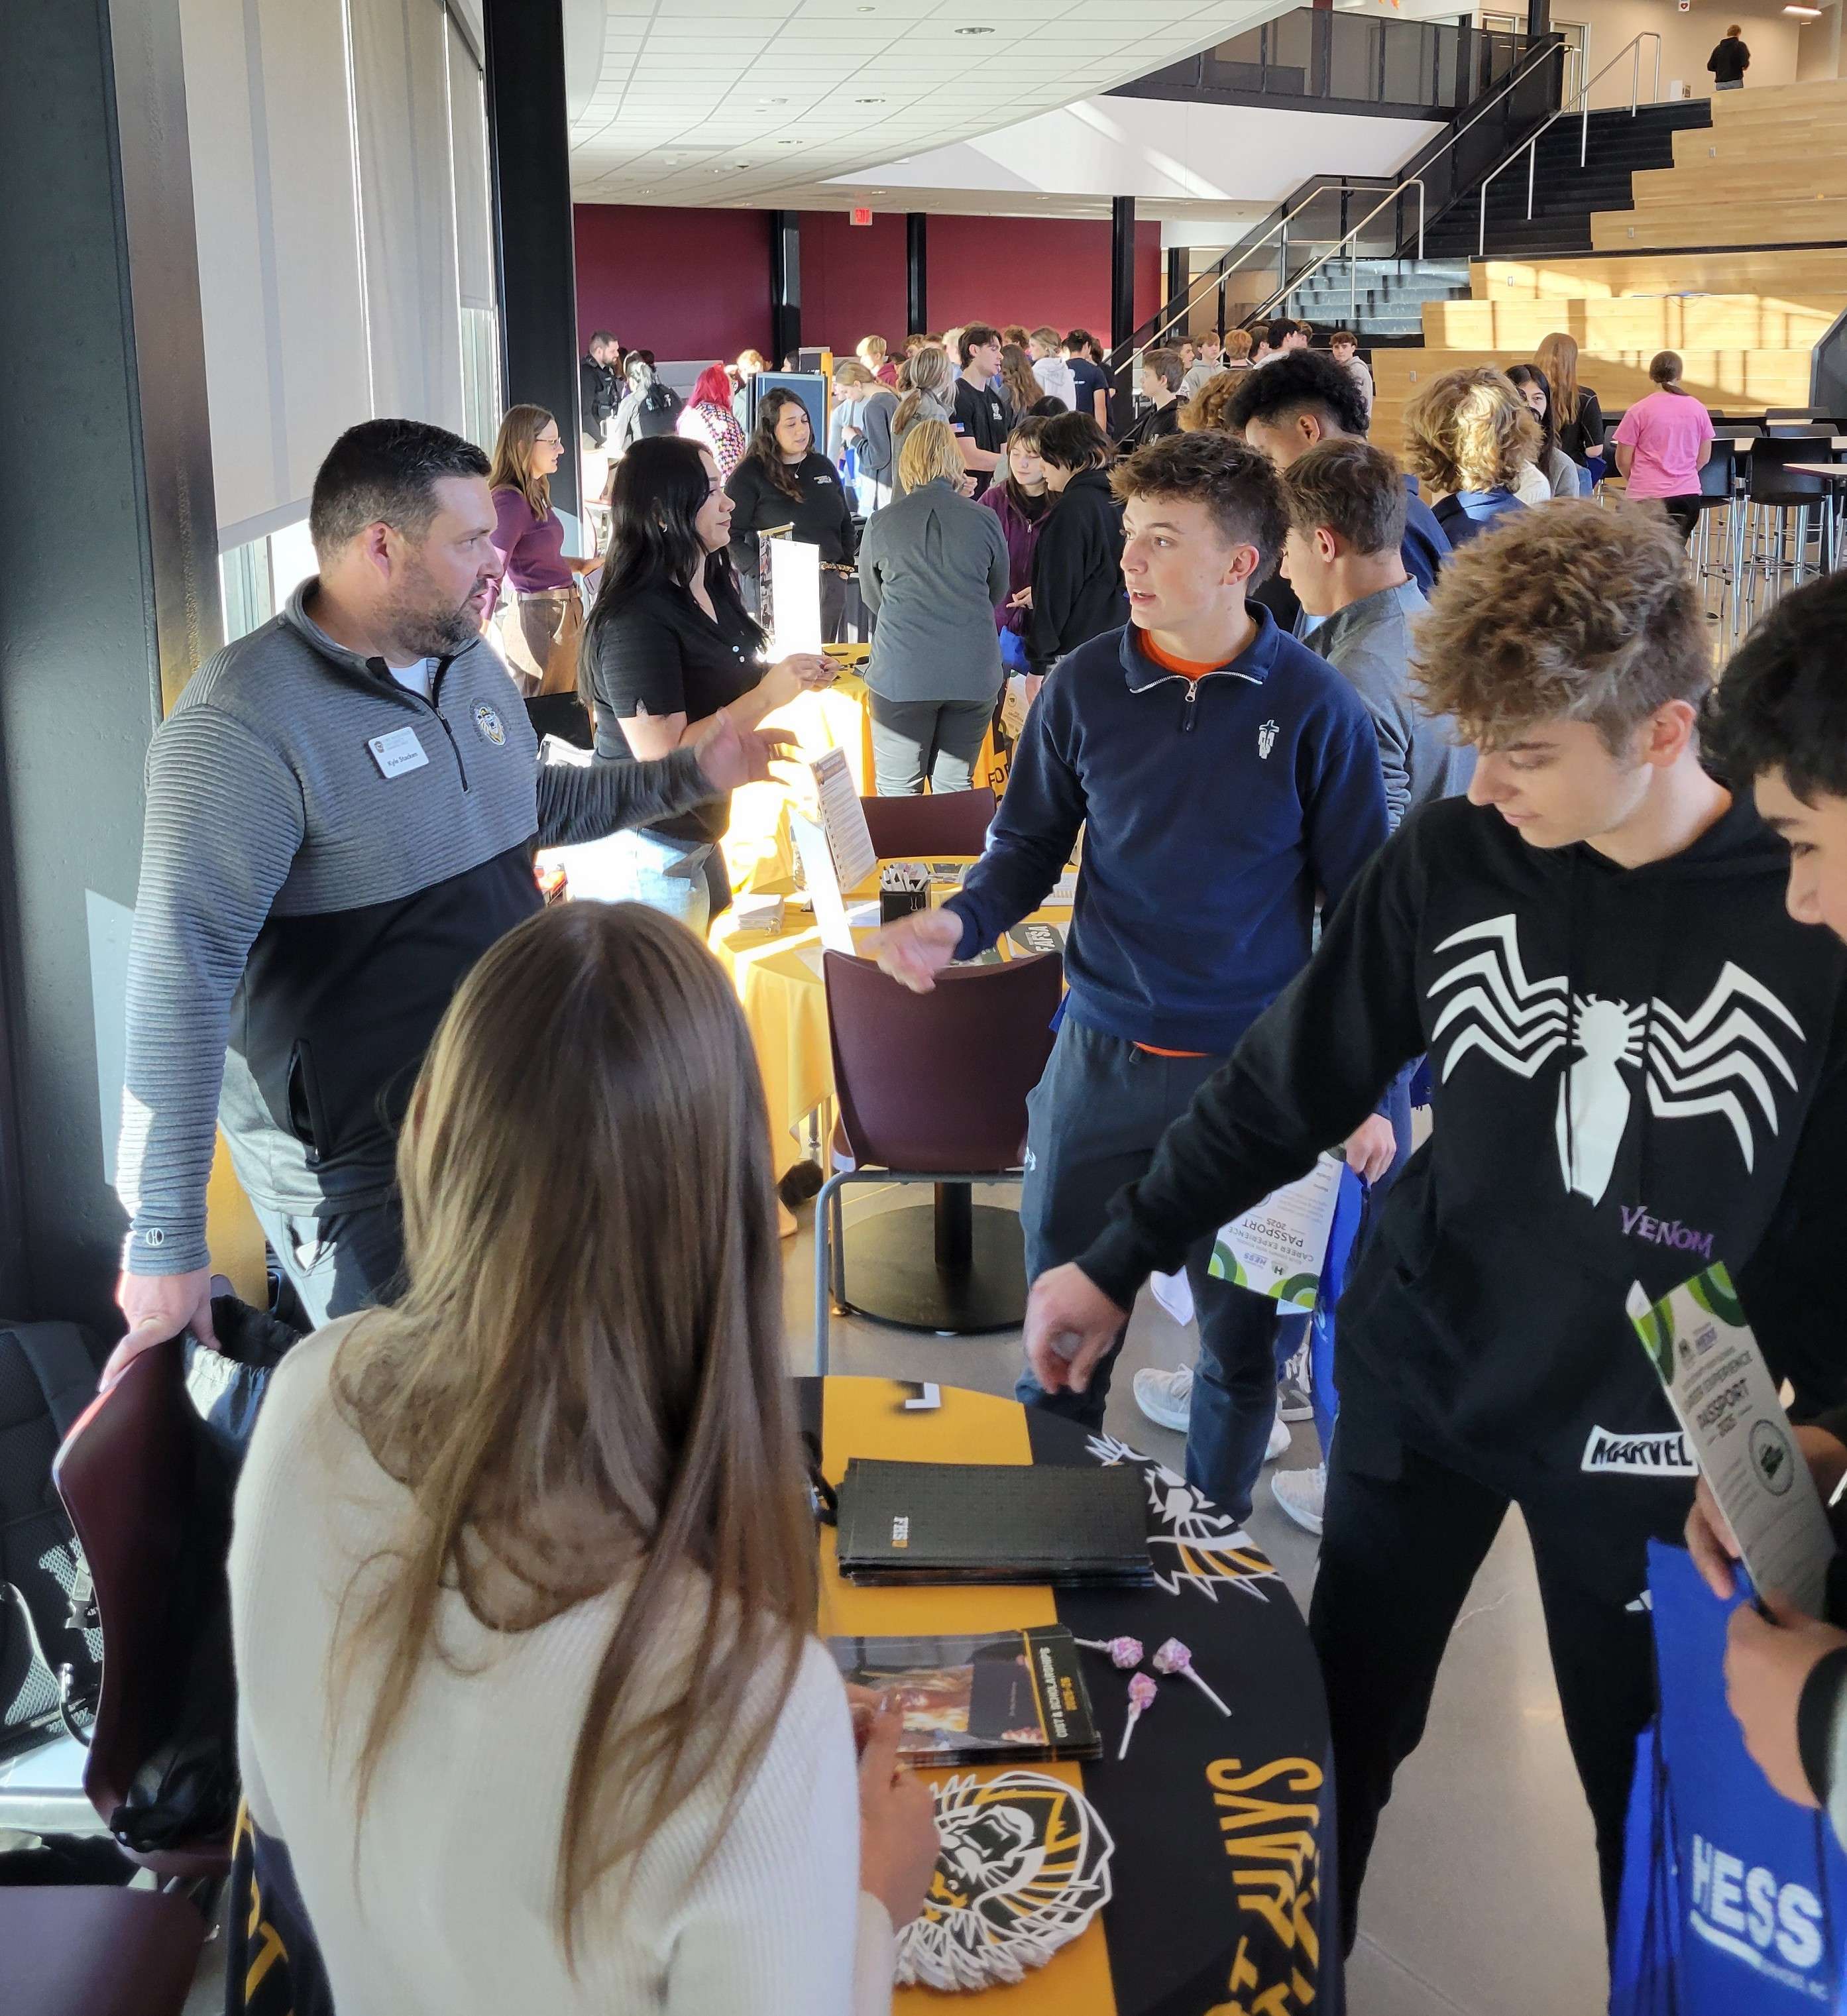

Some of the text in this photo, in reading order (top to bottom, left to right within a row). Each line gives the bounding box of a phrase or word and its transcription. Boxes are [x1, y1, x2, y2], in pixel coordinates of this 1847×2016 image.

[1027, 925, 1056, 952] FAFSA
[1242, 1218, 1304, 1247] PASSPORT
[1266, 1217, 1287, 1231] 2025
[1620, 1204, 1714, 1260] VENOM
[1228, 1226, 1278, 1251] EXPERIENCE
[1280, 1245, 1314, 1262] CAREER
[1589, 1433, 1693, 1467] MARVEL
[1692, 1833, 1824, 1968] HESS
